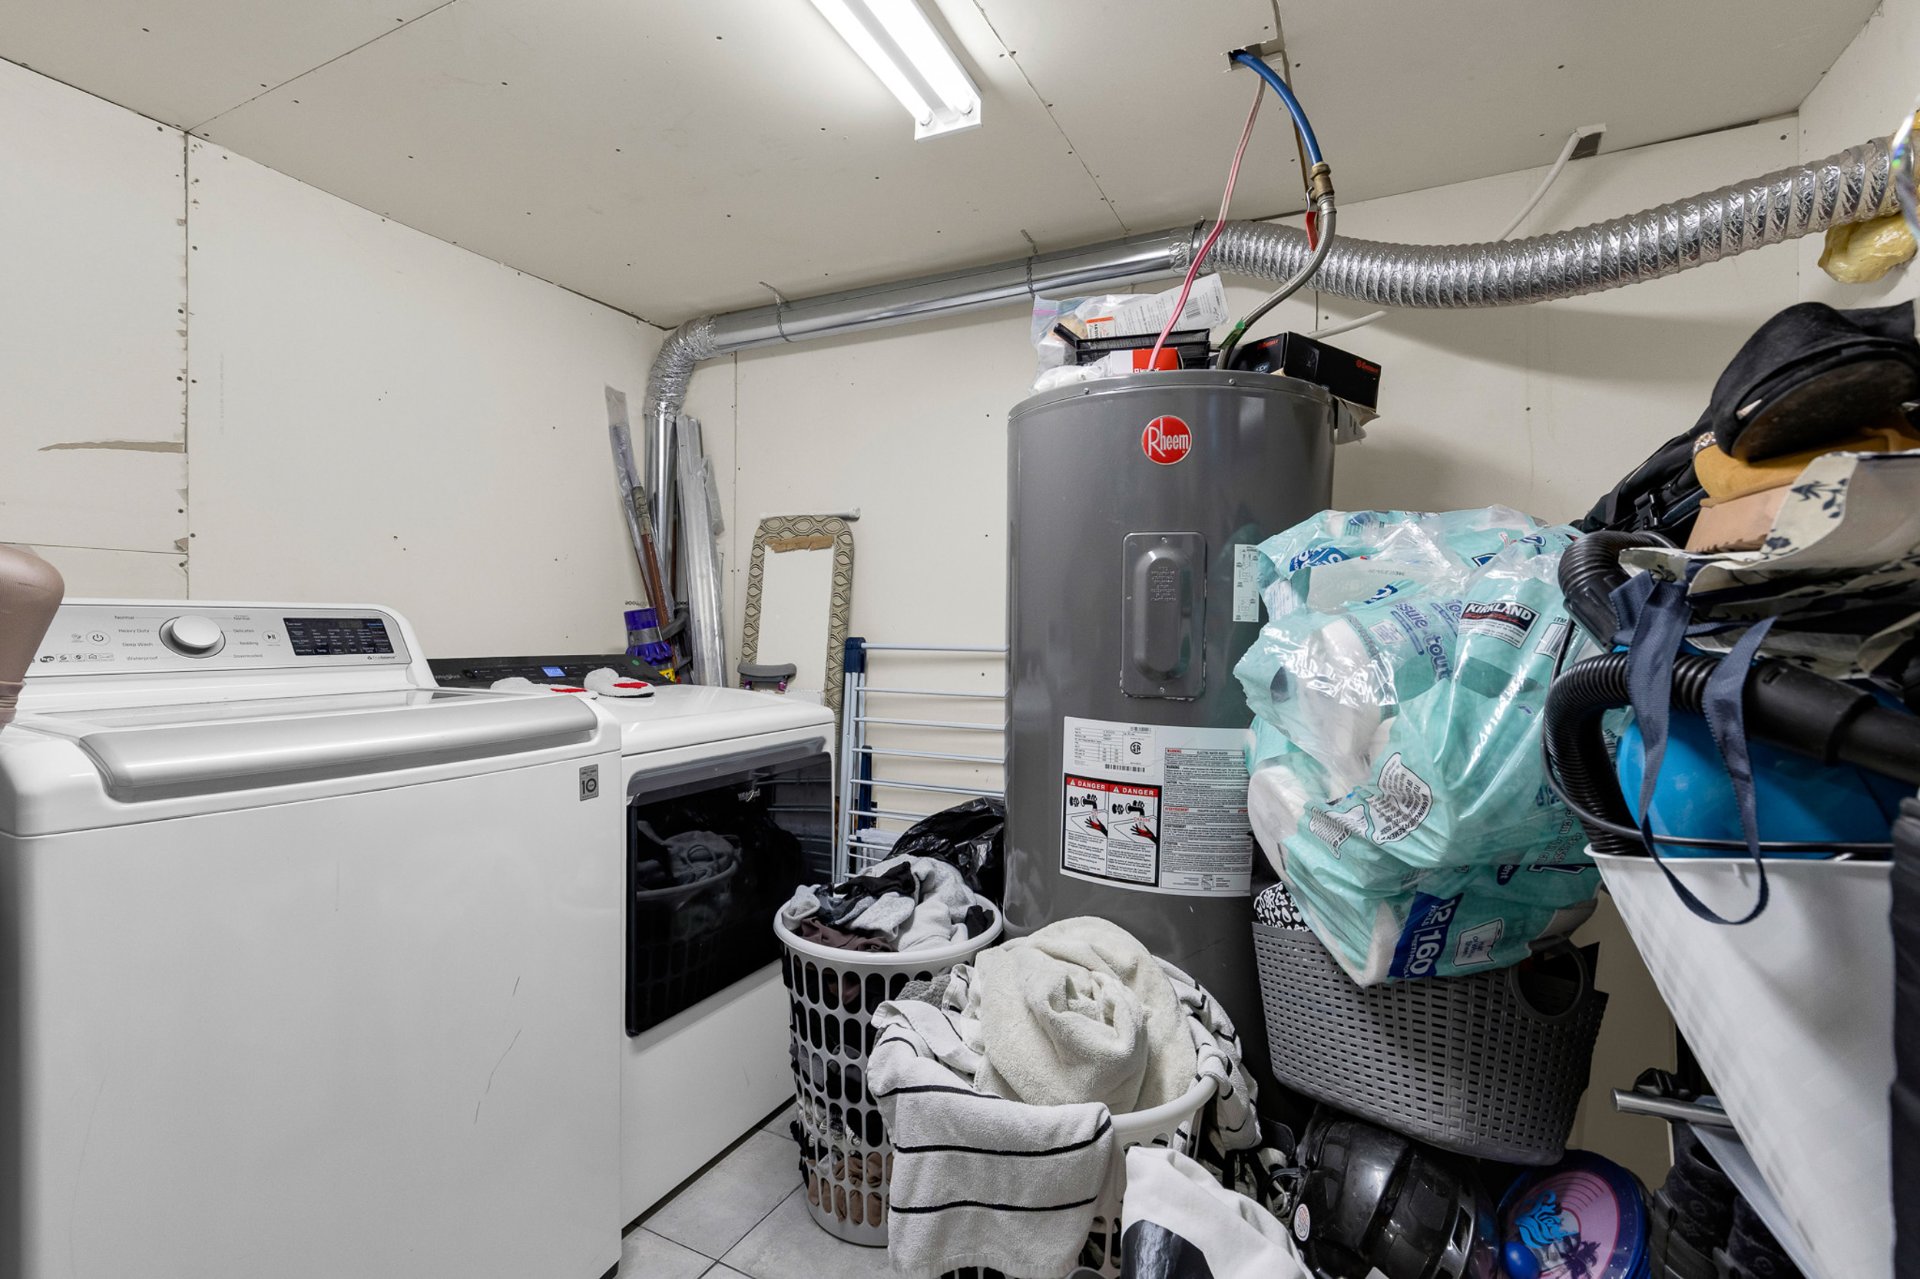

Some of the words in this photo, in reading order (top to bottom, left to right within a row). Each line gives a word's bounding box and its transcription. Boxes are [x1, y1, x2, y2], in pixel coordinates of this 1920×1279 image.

[1147, 417, 1189, 457] Rheem
[1465, 602, 1532, 620] KIRKLAND
[581, 778, 597, 795] 10
[1077, 779, 1106, 791] DANGER
[1122, 787, 1154, 797] DANGER
[1429, 899, 1456, 925] 12
[1409, 929, 1442, 975] 160
